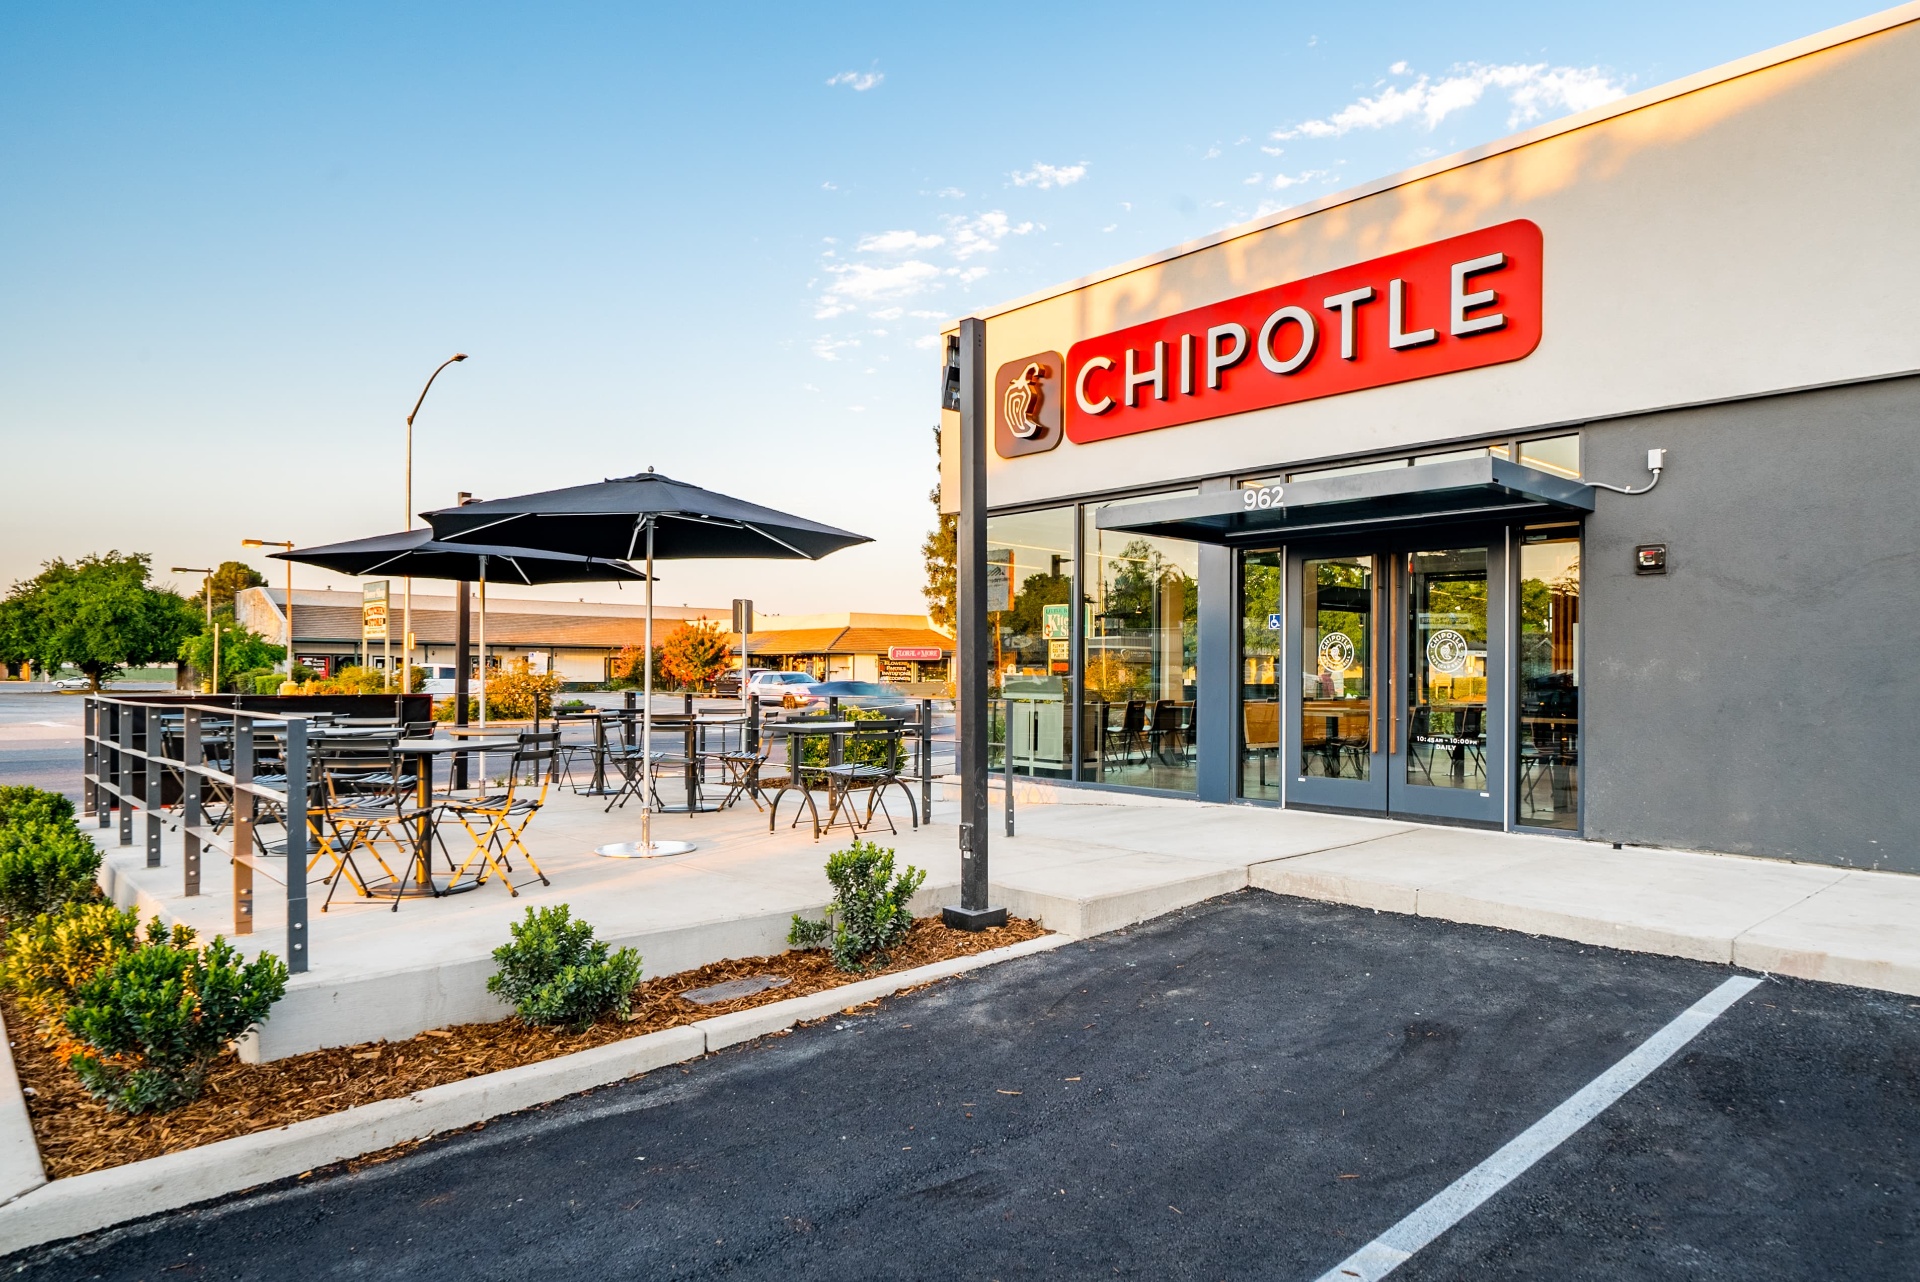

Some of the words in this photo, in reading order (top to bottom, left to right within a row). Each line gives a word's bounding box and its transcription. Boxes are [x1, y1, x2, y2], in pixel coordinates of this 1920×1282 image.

[1075, 252, 1508, 416] CHIPOTLE
[1243, 486, 1284, 511] 962
[1321, 635, 1352, 650] CHIPOTLE
[1430, 632, 1464, 649] CHIPOTLE
[1430, 654, 1451, 669] MEXICAN
